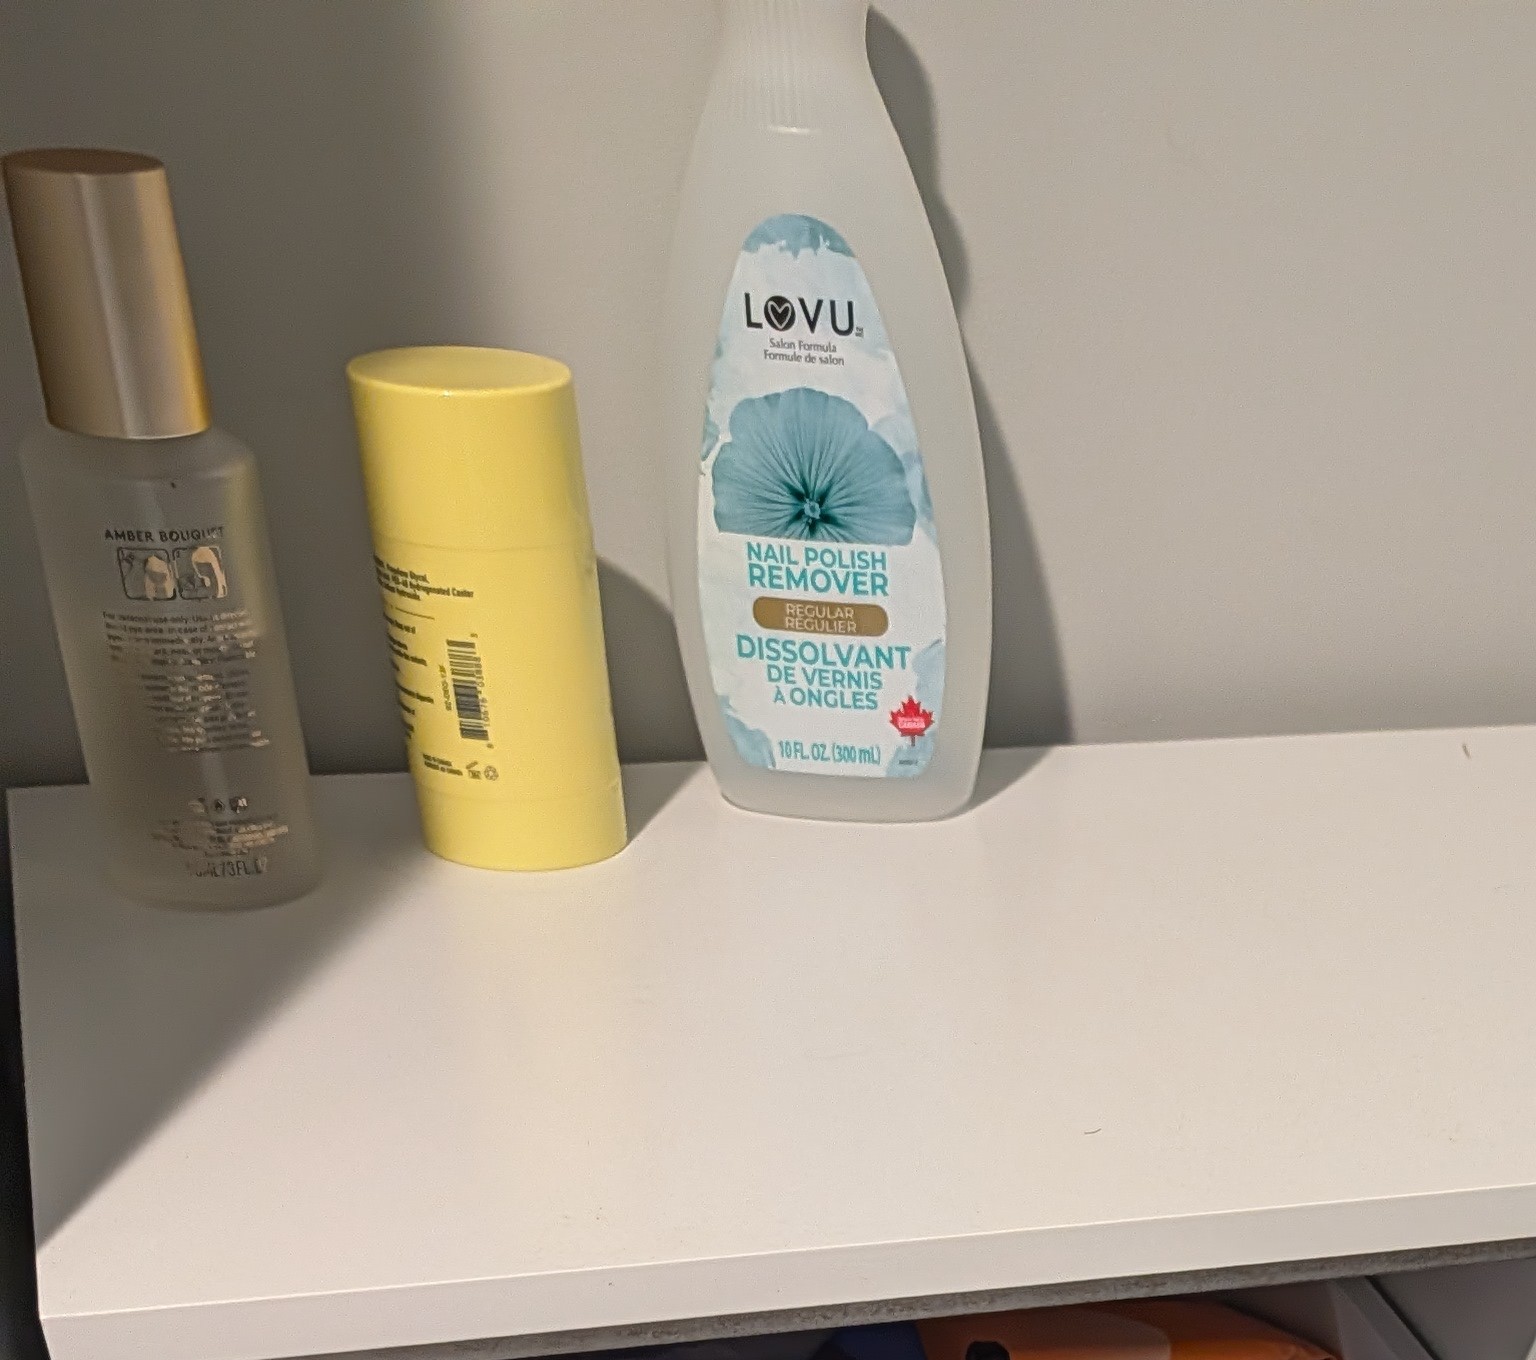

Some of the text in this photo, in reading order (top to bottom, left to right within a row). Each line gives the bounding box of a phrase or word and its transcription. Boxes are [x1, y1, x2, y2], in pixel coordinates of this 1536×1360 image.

[764, 350, 845, 366] Formule de salon
[769, 338, 837, 353] Salon Formula
[104, 530, 154, 542] AMBER
[746, 542, 887, 571] NAIL POLISH
[748, 563, 889, 597] REMOVER
[786, 603, 855, 619] REGULAR
[736, 634, 912, 670] DISSOLVANT
[767, 664, 883, 690] DE VERNIS
[773, 685, 878, 710] À ONGLES
[778, 740, 791, 759] 10
[832, 742, 856, 763] (300
[858, 745, 881, 765] mL)
